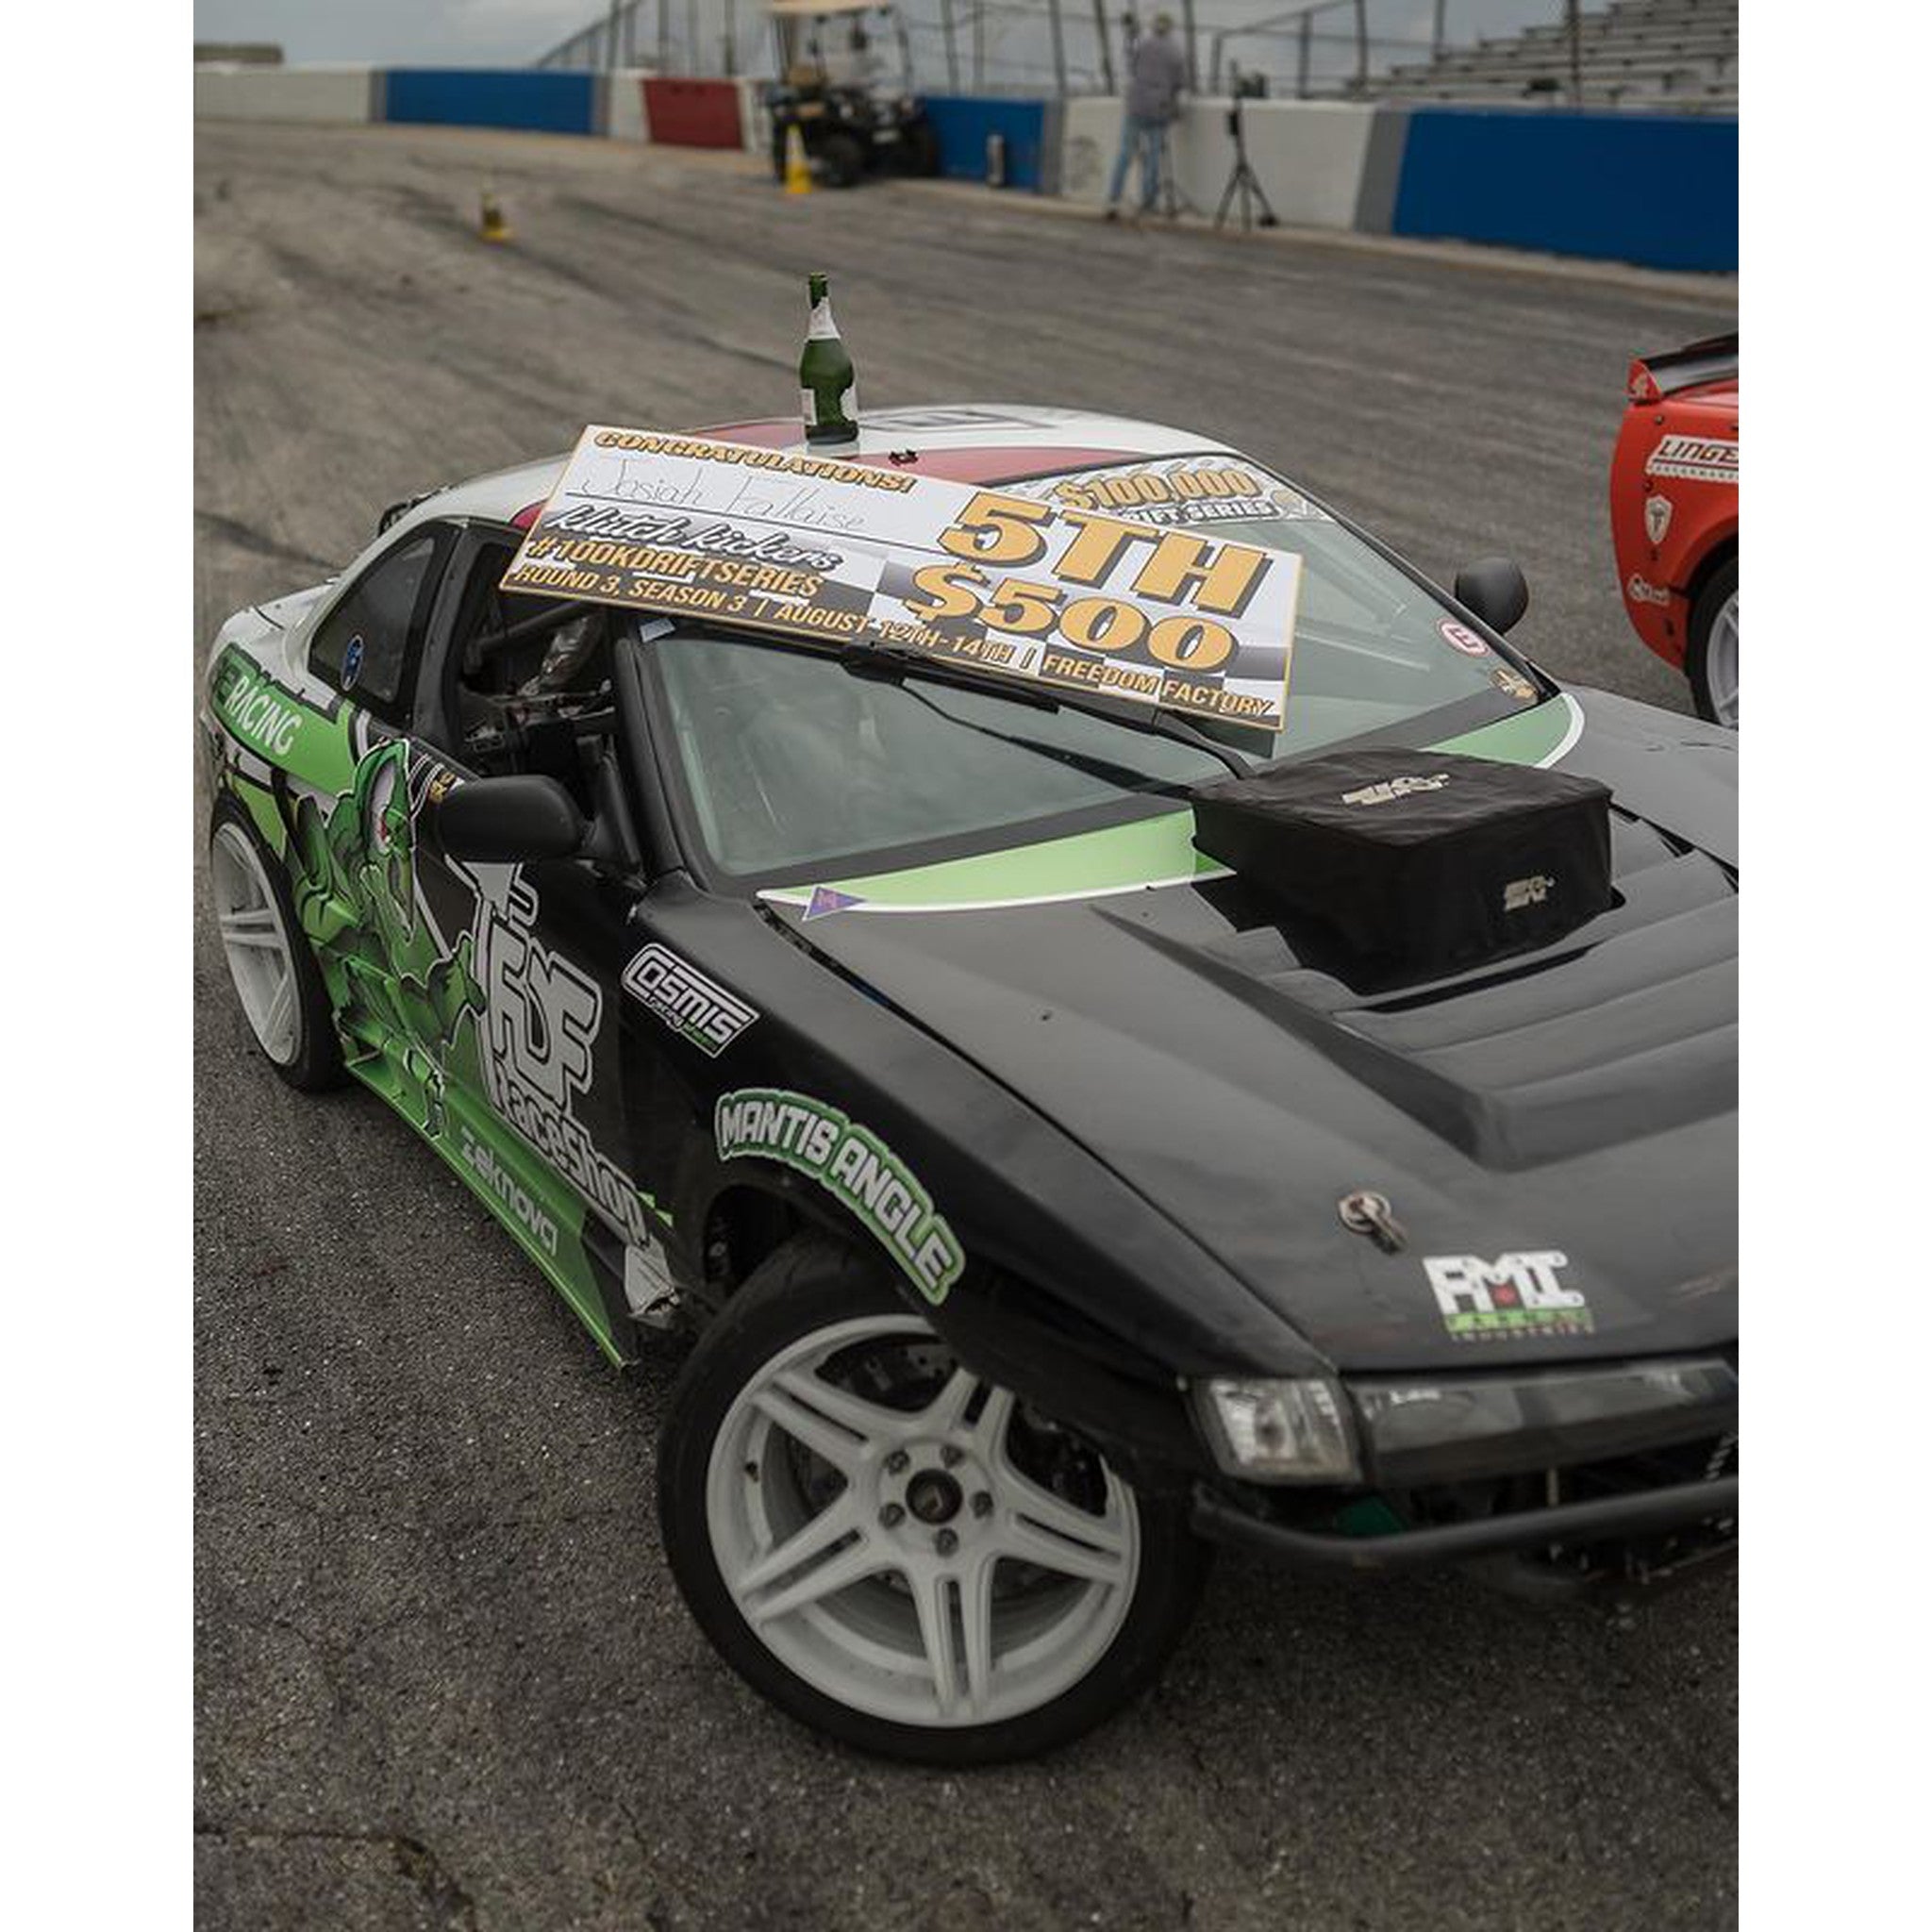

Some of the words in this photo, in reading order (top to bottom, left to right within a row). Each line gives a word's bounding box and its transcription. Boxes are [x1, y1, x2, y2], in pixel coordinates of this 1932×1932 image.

[593, 431, 917, 494] CONGRATULATIONS!
[1054, 470, 1262, 510] $100,000
[1185, 501, 1275, 521] SERIES
[525, 536, 824, 597] #100KDRIFTSERIES
[937, 490, 1274, 619] 5TH
[514, 563, 600, 591] ROUND
[627, 578, 727, 609] SEASON
[727, 594, 748, 613] 3
[773, 601, 870, 634] AUGUST
[1042, 653, 1160, 695] FREEDOM
[1160, 677, 1274, 718] FACTORY
[903, 561, 1241, 673] $500
[224, 675, 303, 756] RACING
[721, 1100, 840, 1167] MANTIS
[829, 1136, 954, 1291] ANGLE
